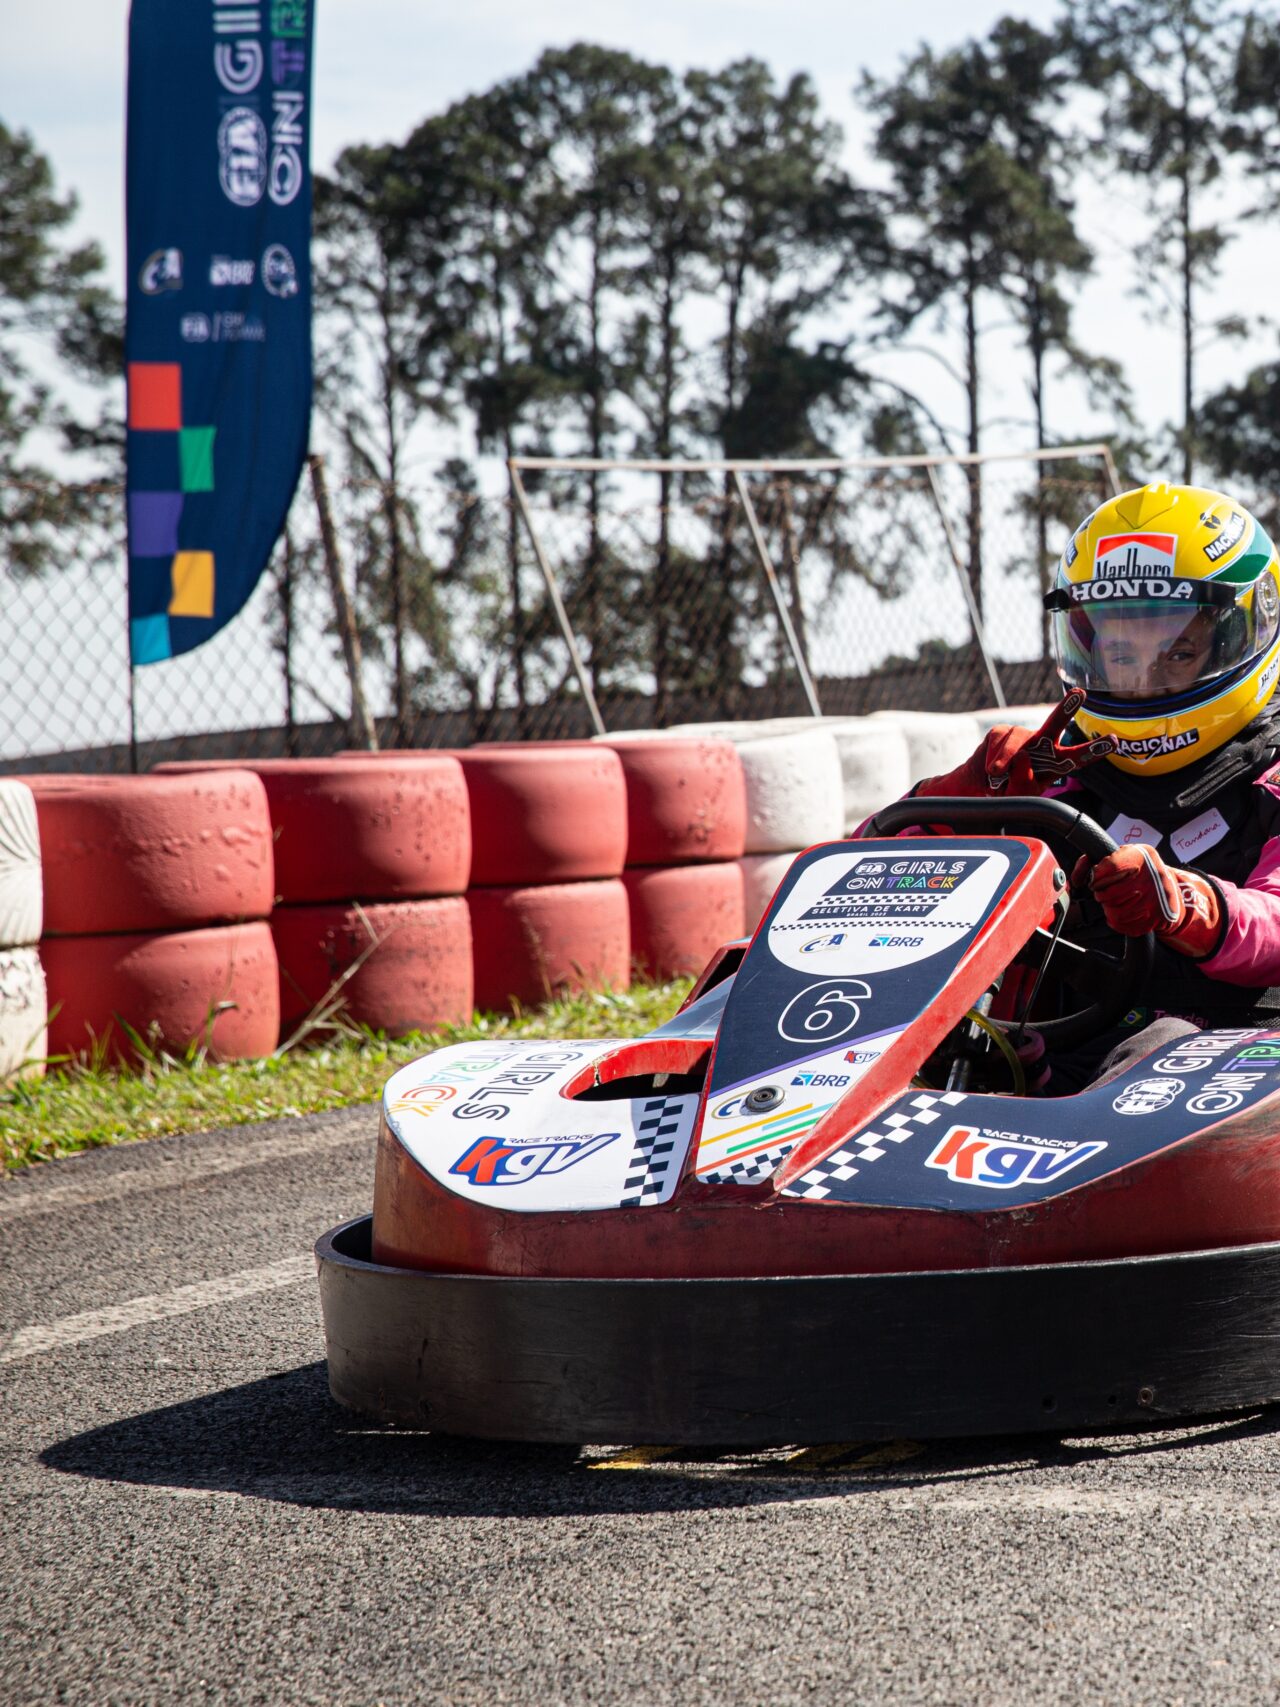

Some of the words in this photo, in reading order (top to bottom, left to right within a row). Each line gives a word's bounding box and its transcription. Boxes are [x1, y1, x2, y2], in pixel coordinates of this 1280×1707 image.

[1096, 548, 1171, 579] Marlboro
[1071, 578, 1193, 601] HONDA
[857, 863, 886, 874] FIA
[890, 861, 967, 875] GIRLS
[846, 877, 885, 890] ON
[886, 876, 959, 889] TRACK
[811, 906, 869, 915] SELETIVA
[886, 936, 924, 947] BRB
[777, 978, 873, 1043] 6
[452, 1051, 583, 1121] GIRLS
[811, 1074, 851, 1087] BRB
[1118, 1079, 1180, 1114] FIA
[1185, 1072, 1267, 1115] ON
[544, 1133, 595, 1142] TRACKS
[983, 1128, 1021, 1142] RACE
[1022, 1134, 1079, 1148] TRACKS
